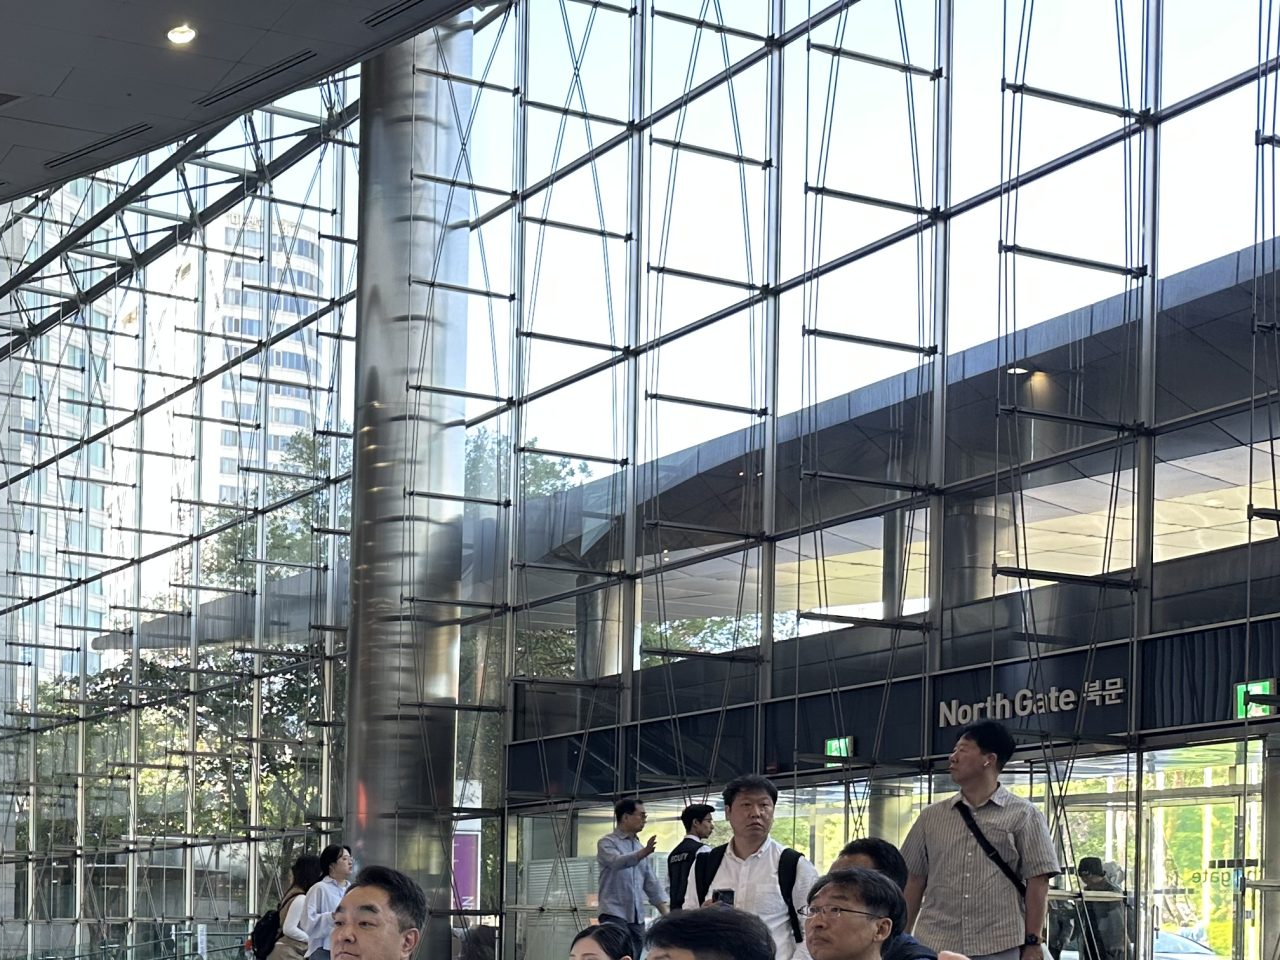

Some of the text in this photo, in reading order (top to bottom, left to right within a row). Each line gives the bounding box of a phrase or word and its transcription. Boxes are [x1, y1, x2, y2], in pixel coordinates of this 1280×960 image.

[939, 677, 1126, 728] North Gate 북문
